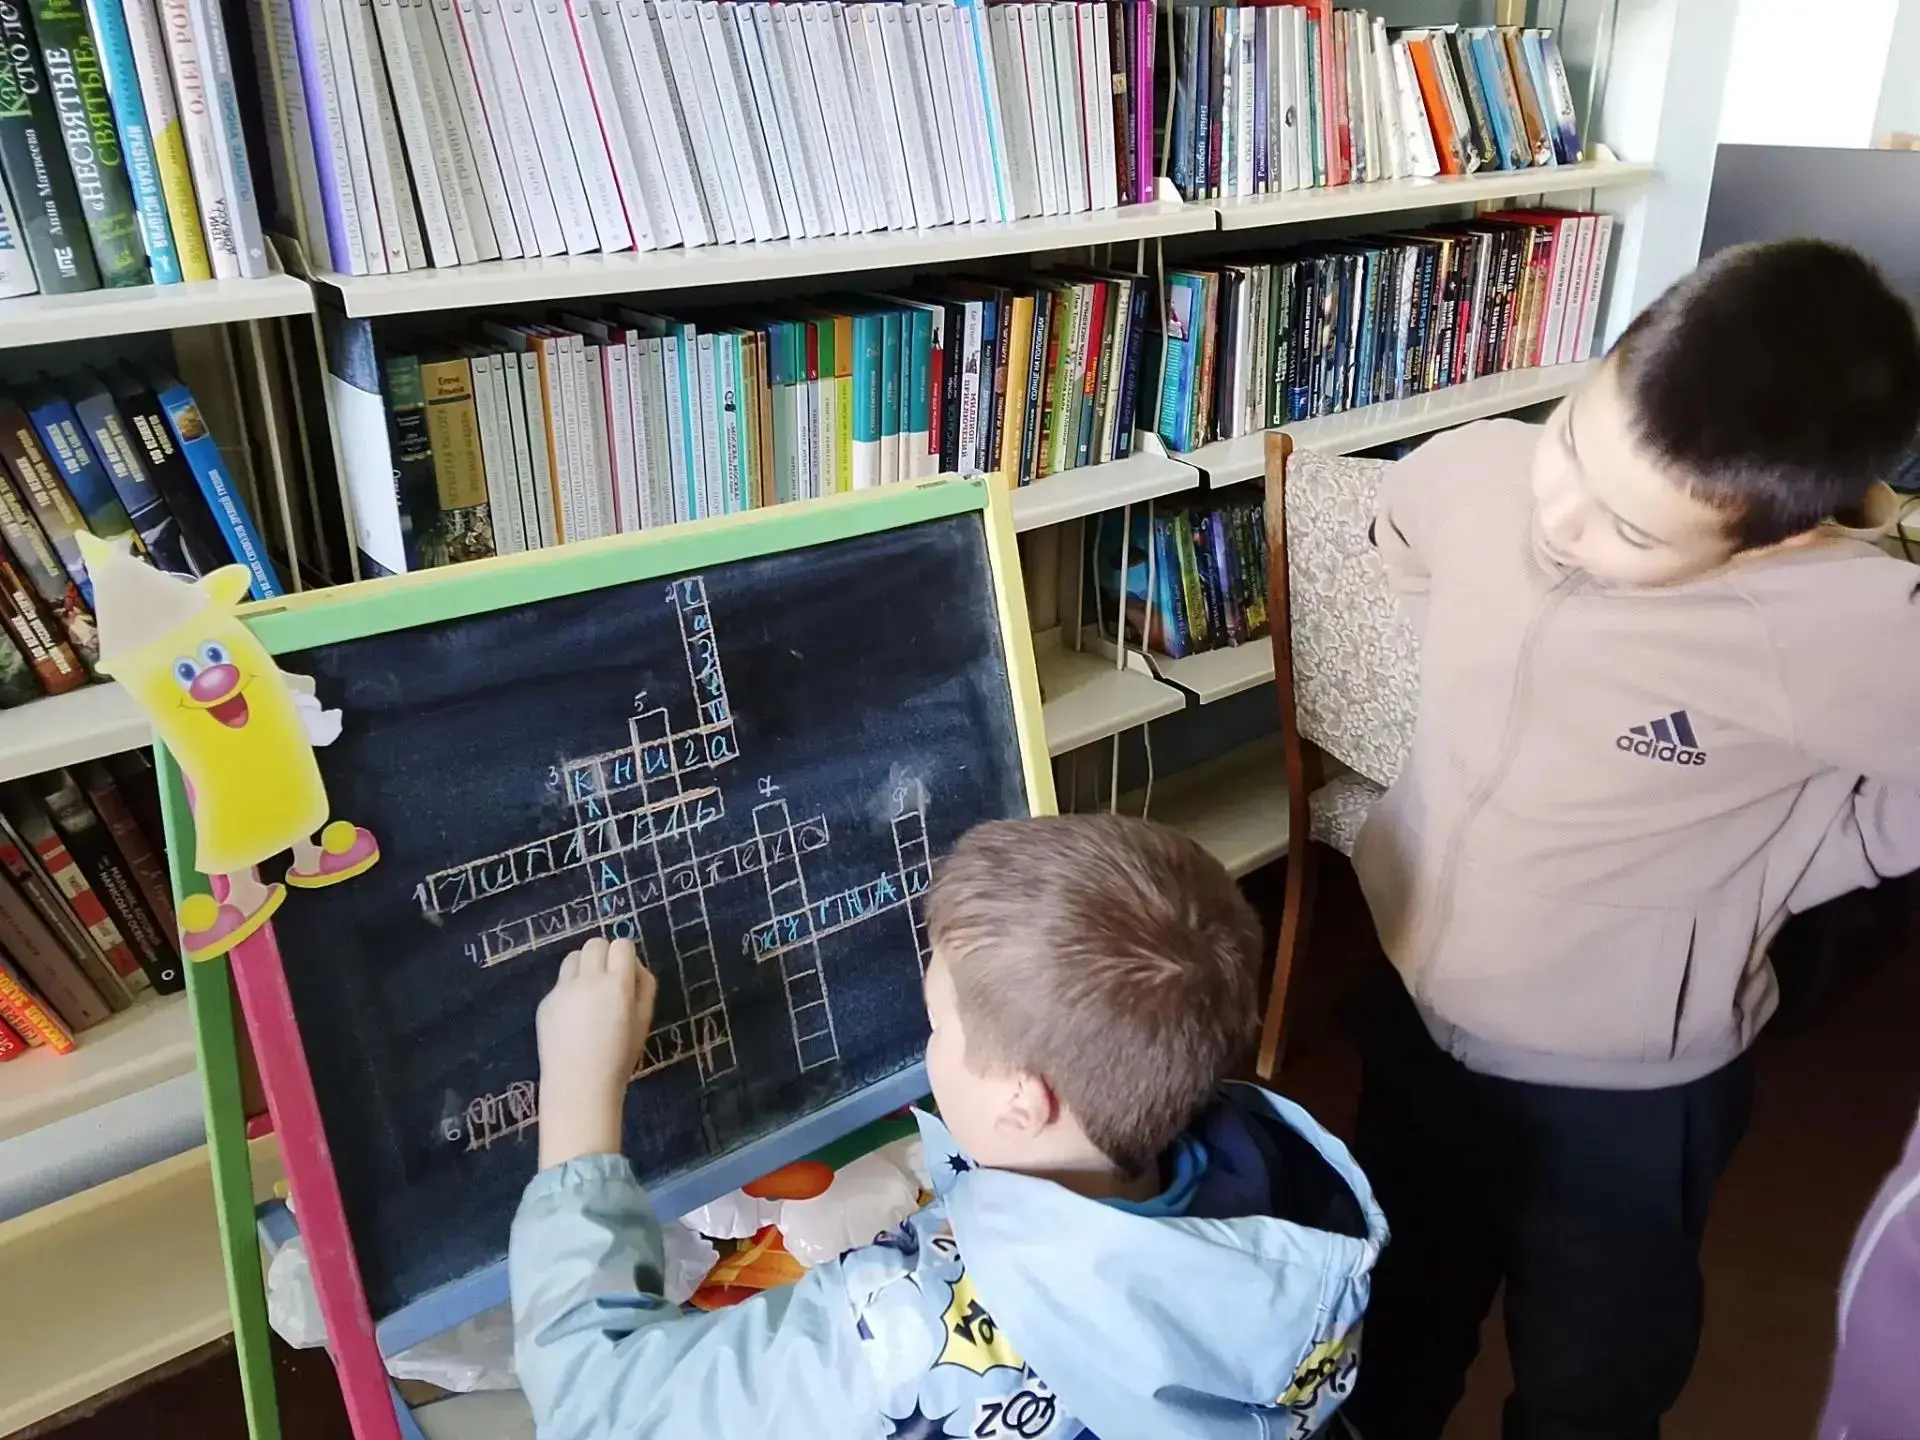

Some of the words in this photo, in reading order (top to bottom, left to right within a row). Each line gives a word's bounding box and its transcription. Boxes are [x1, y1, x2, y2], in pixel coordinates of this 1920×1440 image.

[70, 34, 122, 169] СВЯТЫЕ»
[177, 51, 208, 117] ОЛЕГ
[45, 45, 107, 215] «НЕСВЯТЫЕ
[1198, 105, 1208, 136] круиз
[218, 81, 240, 140] СТОРОНА
[230, 144, 254, 203] ЗАЩИТЫ
[23, 127, 53, 198] Матвеева
[1196, 141, 1206, 184] Роковой
[123, 123, 157, 195] ИРКУТСКАЯ
[140, 194, 170, 250] ИСТОРИЯ
[43, 199, 64, 237] Анна
[208, 215, 224, 243] ТЕНИ
[214, 198, 237, 256] ДОНБАССА
[1073, 293, 1081, 310] Лев
[1417, 254, 1434, 337] КРЫСЯТНИК
[1033, 316, 1046, 360] ПОЛОВИЦАХ
[1069, 311, 1080, 345] Толстой
[1079, 300, 1091, 343] НАСЕКОМЫХ
[1033, 361, 1041, 371] НА
[1077, 344, 1085, 367] ЖИЗНЬ
[1030, 372, 1040, 401] СОЛНЦЕ
[133, 413, 159, 451] ВЕЛИКИХ
[147, 413, 175, 457] ФИЛОЛОГОВ
[960, 380, 971, 458] ПРИКЛЮЧЕНИЙ
[968, 393, 977, 444] МИЛЛИОН
[45, 422, 72, 459] ВЕЛИКИХ
[94, 427, 121, 464] ВЕЛИКИХ
[149, 448, 166, 466] 100
[15, 455, 43, 493] ВЕЛИКИХ
[63, 456, 81, 475] 100
[112, 461, 129, 480] 100
[34, 490, 51, 508] 100
[232, 525, 258, 563] СИМВОЛОВ
[11, 613, 39, 648] ВЕЛИКИХ
[30, 645, 48, 662] 100
[1616, 735, 1707, 766] adidas
